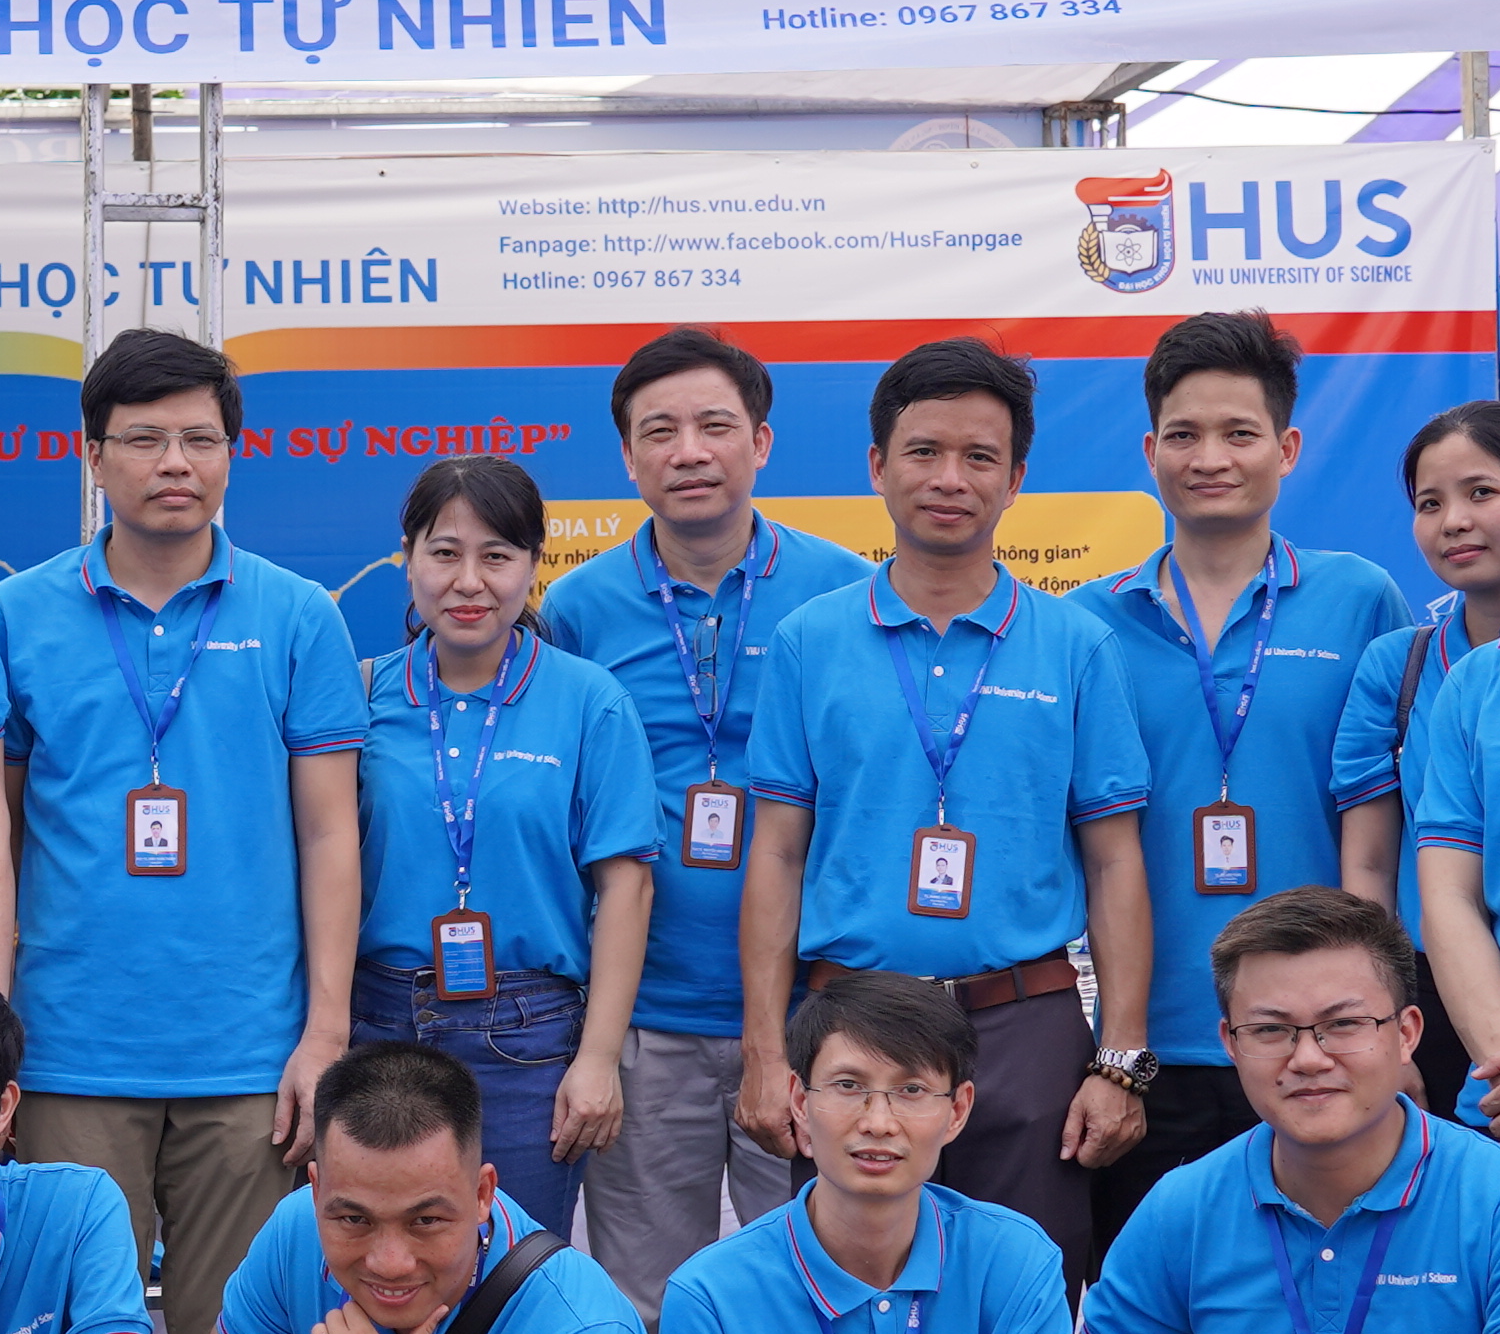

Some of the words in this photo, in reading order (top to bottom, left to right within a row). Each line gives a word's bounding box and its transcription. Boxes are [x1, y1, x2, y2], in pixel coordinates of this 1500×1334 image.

[763, 5, 888, 31] Hotline:
[899, 2, 976, 27] 0967
[985, 0, 1048, 24] 867
[1188, 178, 1413, 262] HUS
